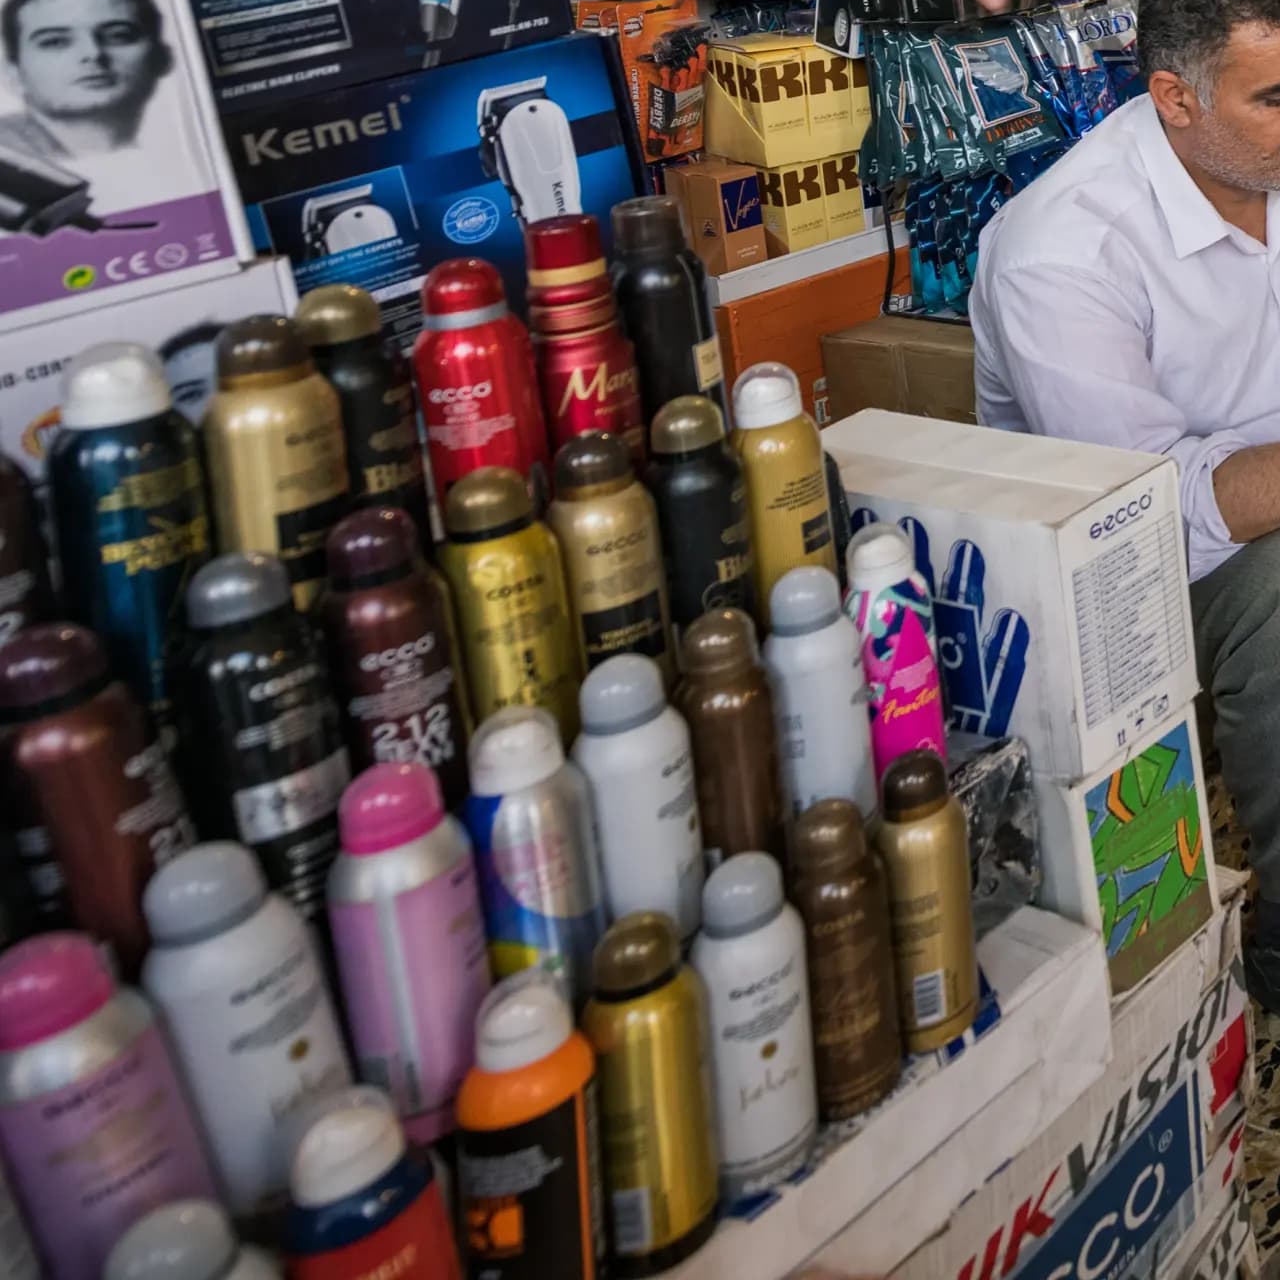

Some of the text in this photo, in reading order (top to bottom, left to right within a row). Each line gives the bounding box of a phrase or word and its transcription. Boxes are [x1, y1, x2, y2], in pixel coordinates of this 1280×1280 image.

[1077, 14, 1133, 44] LORD
[221, 63, 341, 100] ELECTRIC HAIR CLIPPERS
[650, 87, 663, 130] DERBY
